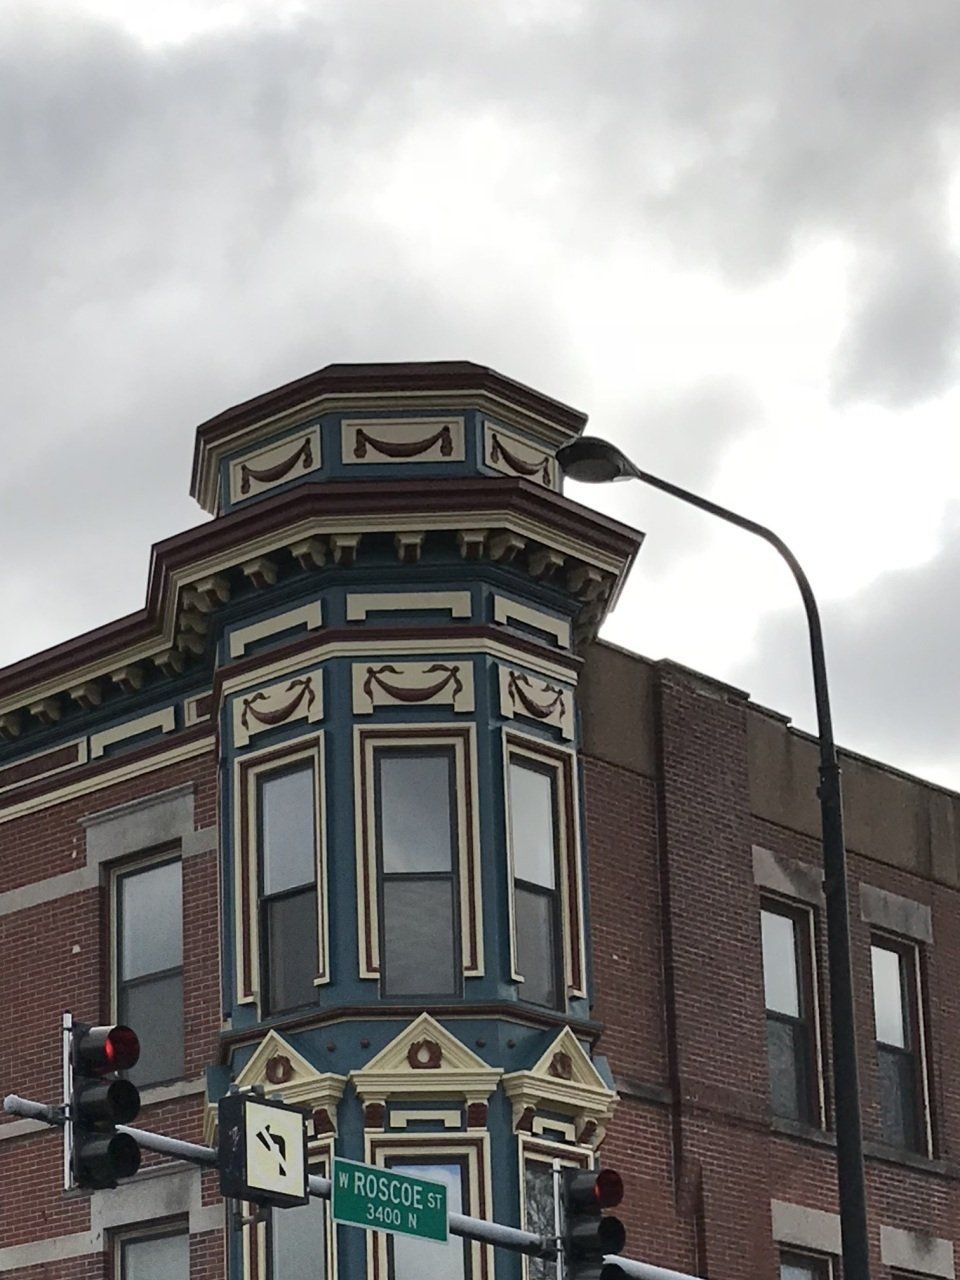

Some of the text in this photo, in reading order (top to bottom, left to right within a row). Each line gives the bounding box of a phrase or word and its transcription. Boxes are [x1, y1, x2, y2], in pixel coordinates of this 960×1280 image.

[338, 1171, 443, 1210] W ROSCOE ST
[366, 1203, 418, 1230] 3400 N
